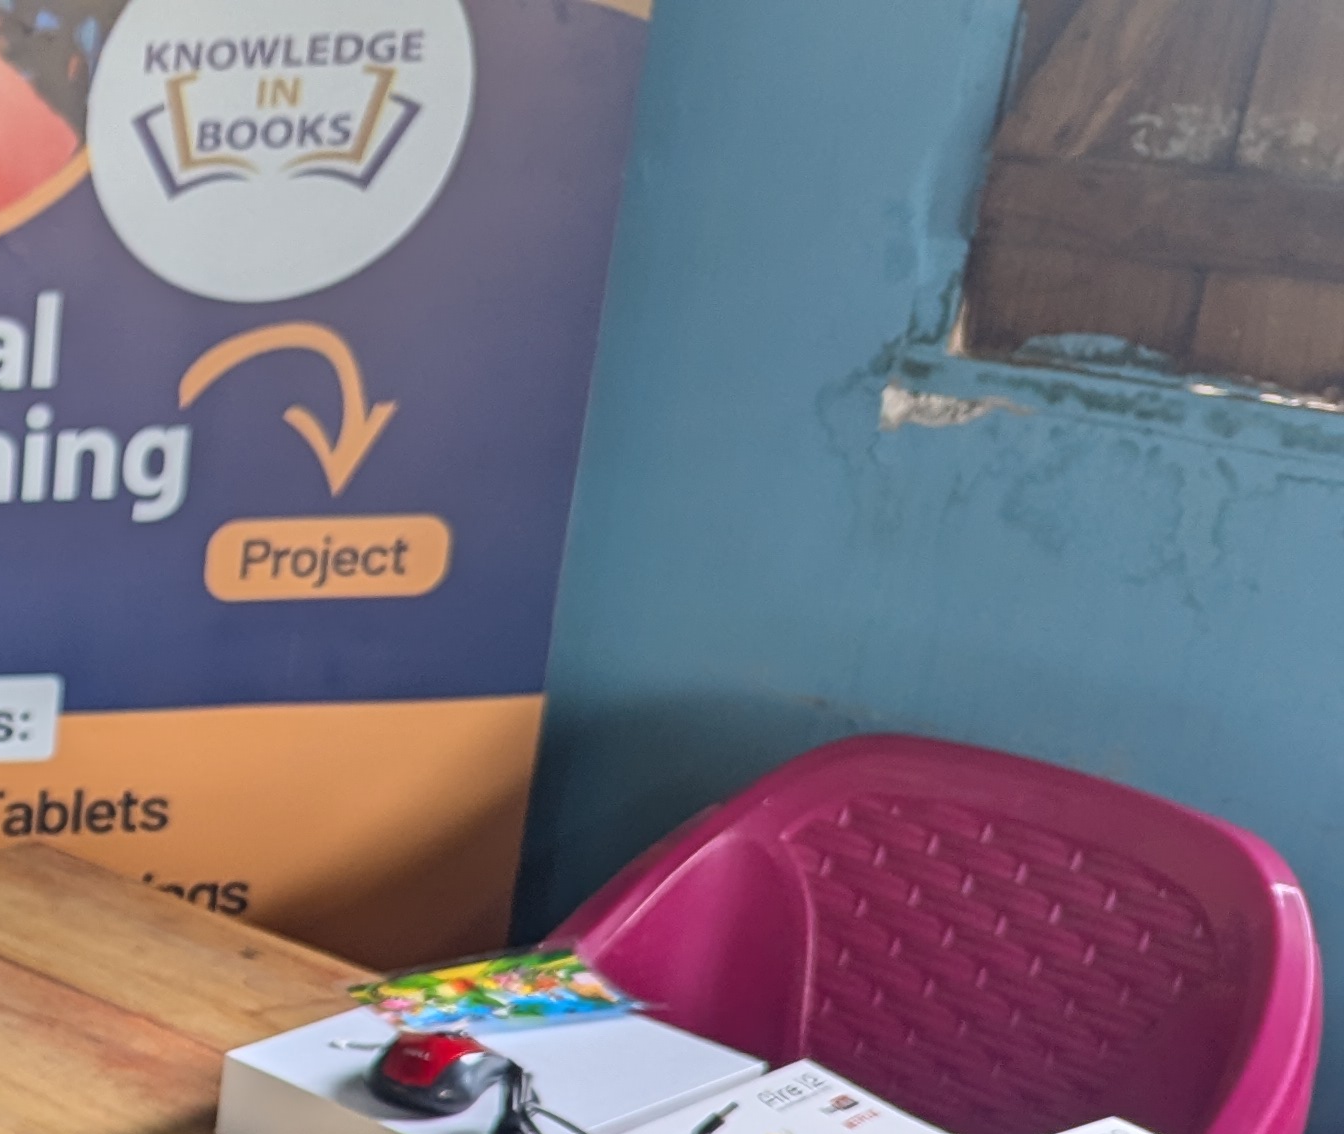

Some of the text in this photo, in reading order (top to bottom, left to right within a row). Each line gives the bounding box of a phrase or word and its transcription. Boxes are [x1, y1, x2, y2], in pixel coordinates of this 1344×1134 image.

[143, 29, 425, 74] KNOWLEDGE
[256, 76, 303, 109] IN
[196, 112, 352, 151] BOOKS
[239, 534, 409, 589] Project
